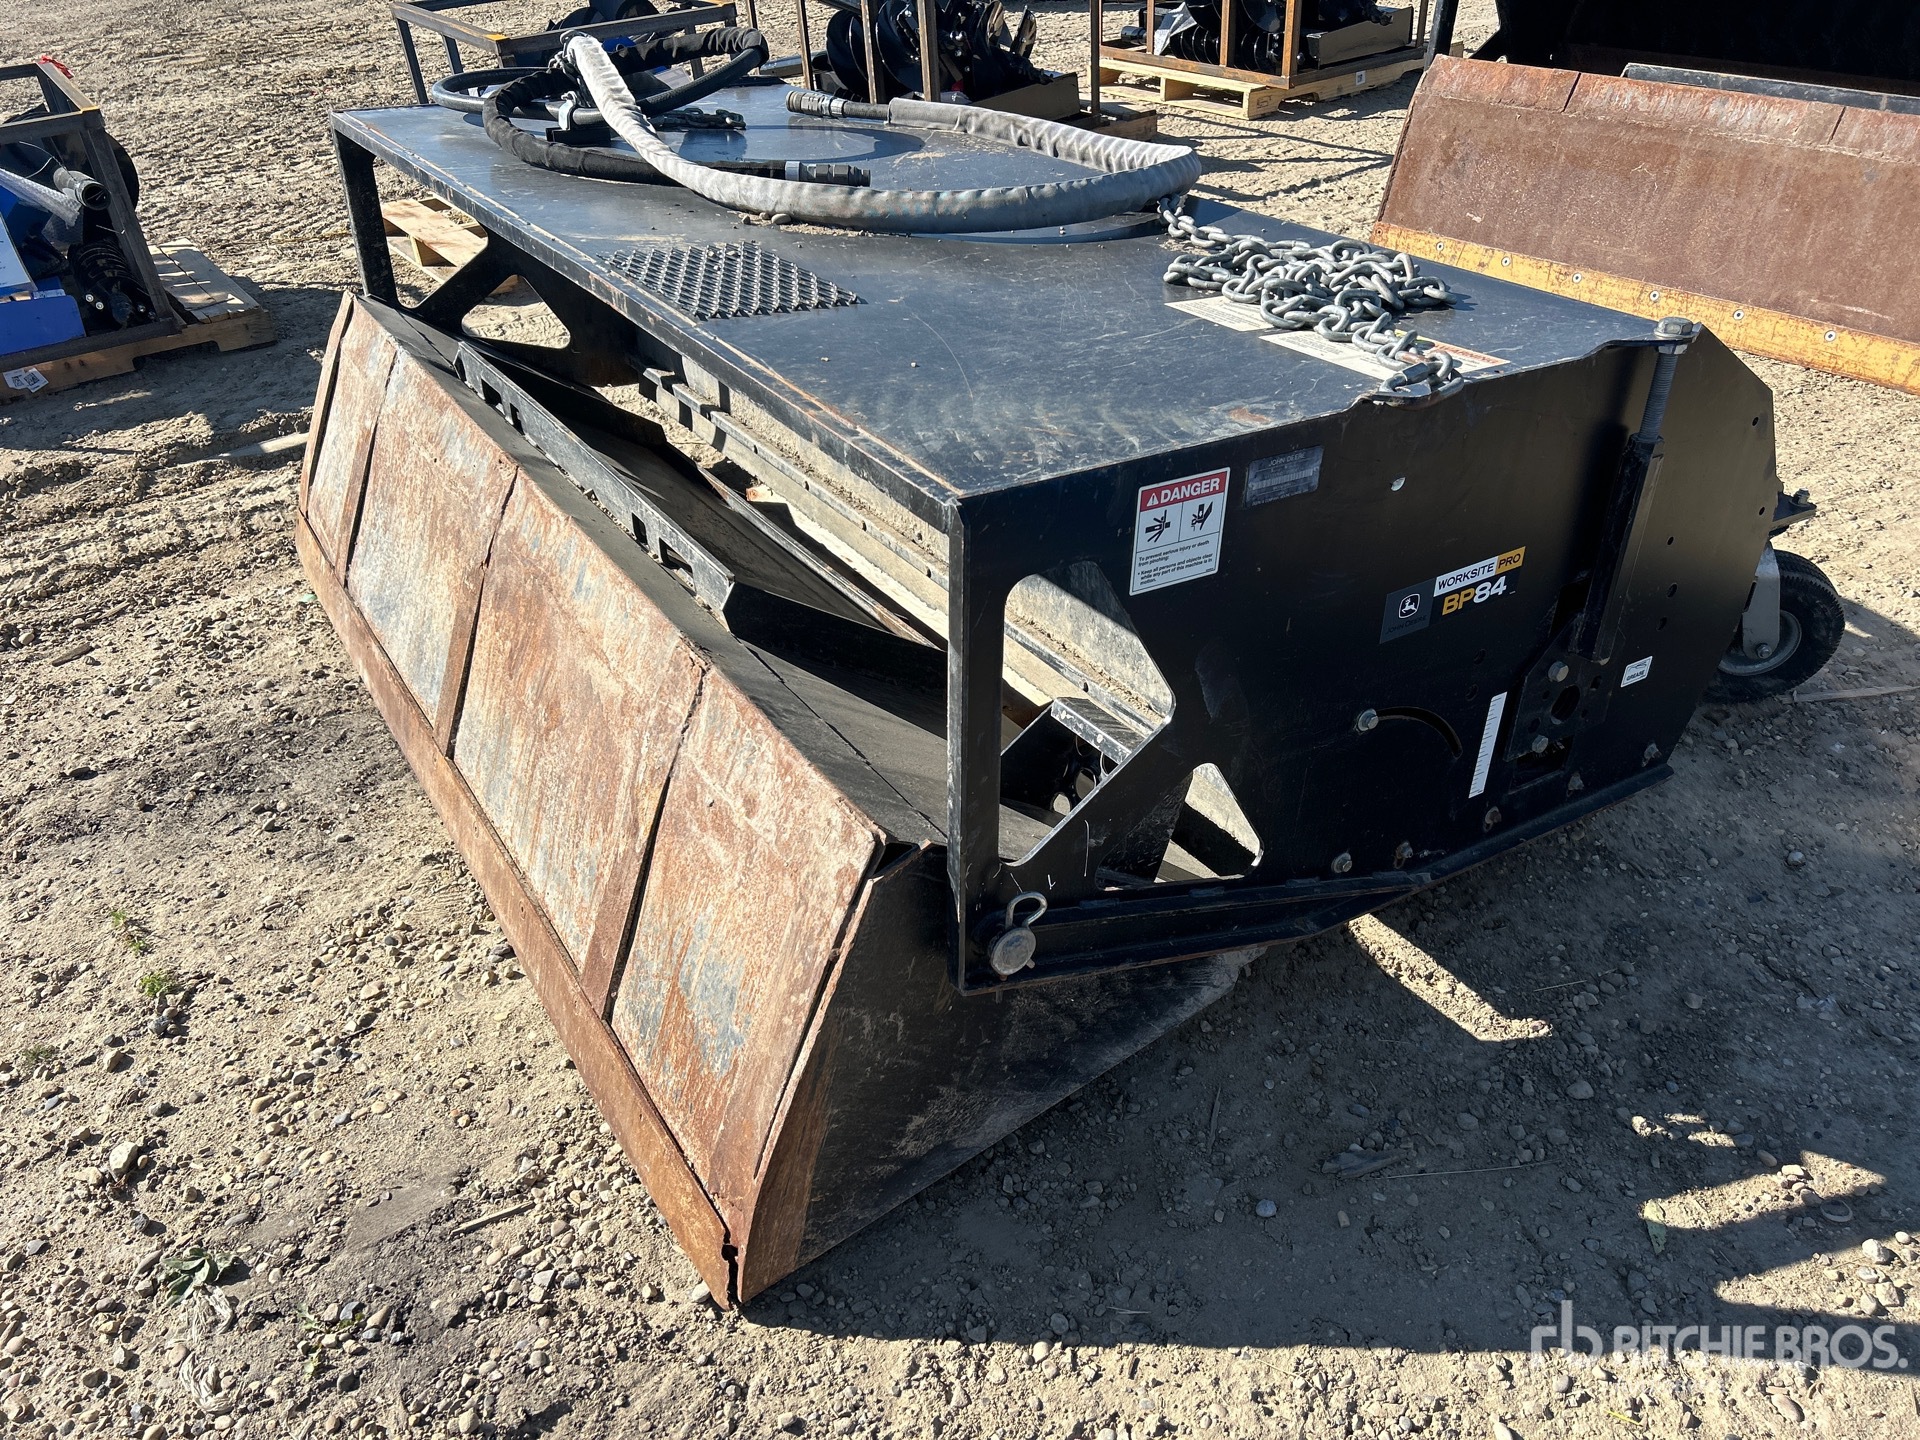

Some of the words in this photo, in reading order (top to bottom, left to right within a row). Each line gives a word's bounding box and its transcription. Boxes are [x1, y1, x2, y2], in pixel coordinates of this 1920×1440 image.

[1268, 458, 1285, 467] JOHN
[1286, 452, 1306, 462] DEERE
[1161, 478, 1220, 503] DANGER
[1141, 568, 1152, 576] Keep
[1159, 563, 1176, 571] persons
[1186, 556, 1202, 564] objects
[1146, 552, 1162, 561] prevent
[1185, 560, 1203, 569] machine
[1438, 562, 1495, 590] WORKSITE
[1498, 553, 1521, 569] PRO
[1441, 575, 1507, 616] BP84
[1386, 624, 1403, 635] JOHN
[1404, 615, 1427, 628] DEERE
[1627, 670, 1645, 681] GREASE
